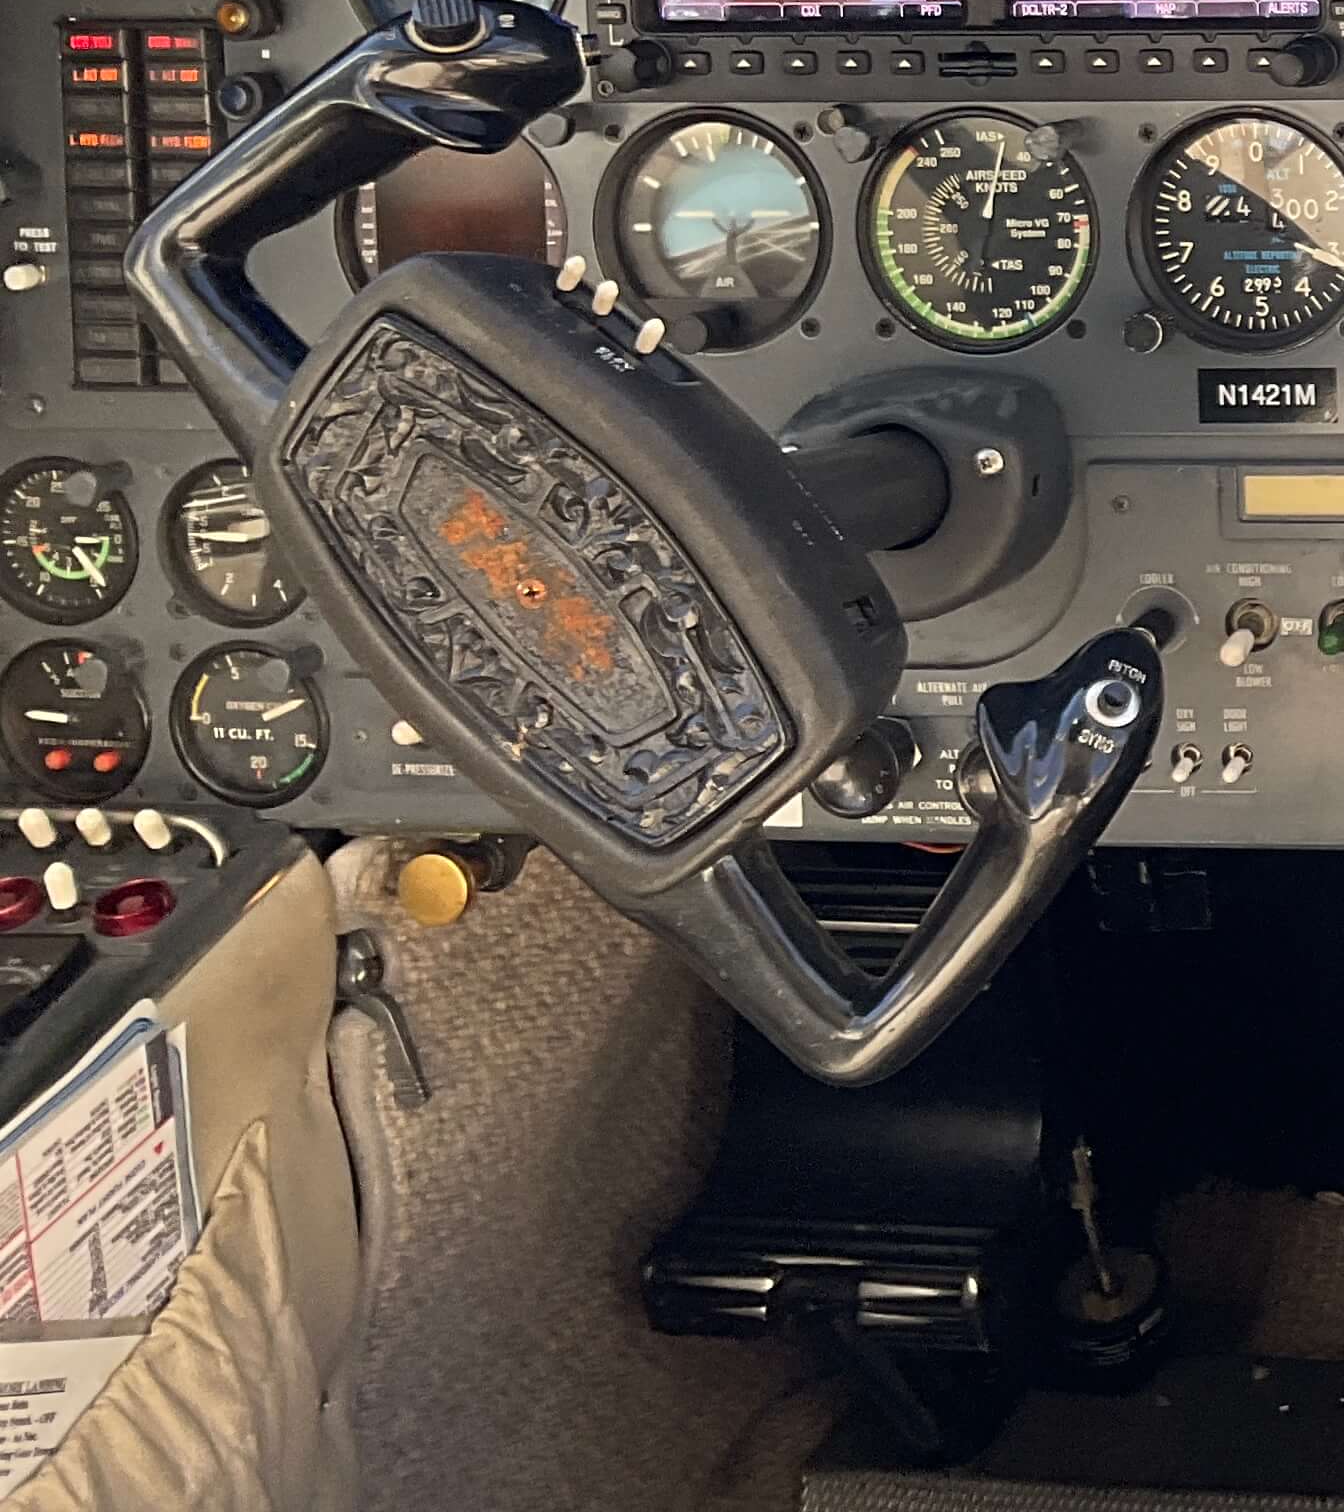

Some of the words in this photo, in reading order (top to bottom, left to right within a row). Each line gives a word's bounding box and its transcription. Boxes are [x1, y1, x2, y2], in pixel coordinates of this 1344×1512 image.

[1001, 260, 1023, 270] TAS
[1218, 384, 1316, 406] N1421M
[229, 728, 252, 739] CU.
[256, 728, 274, 740] FT.
